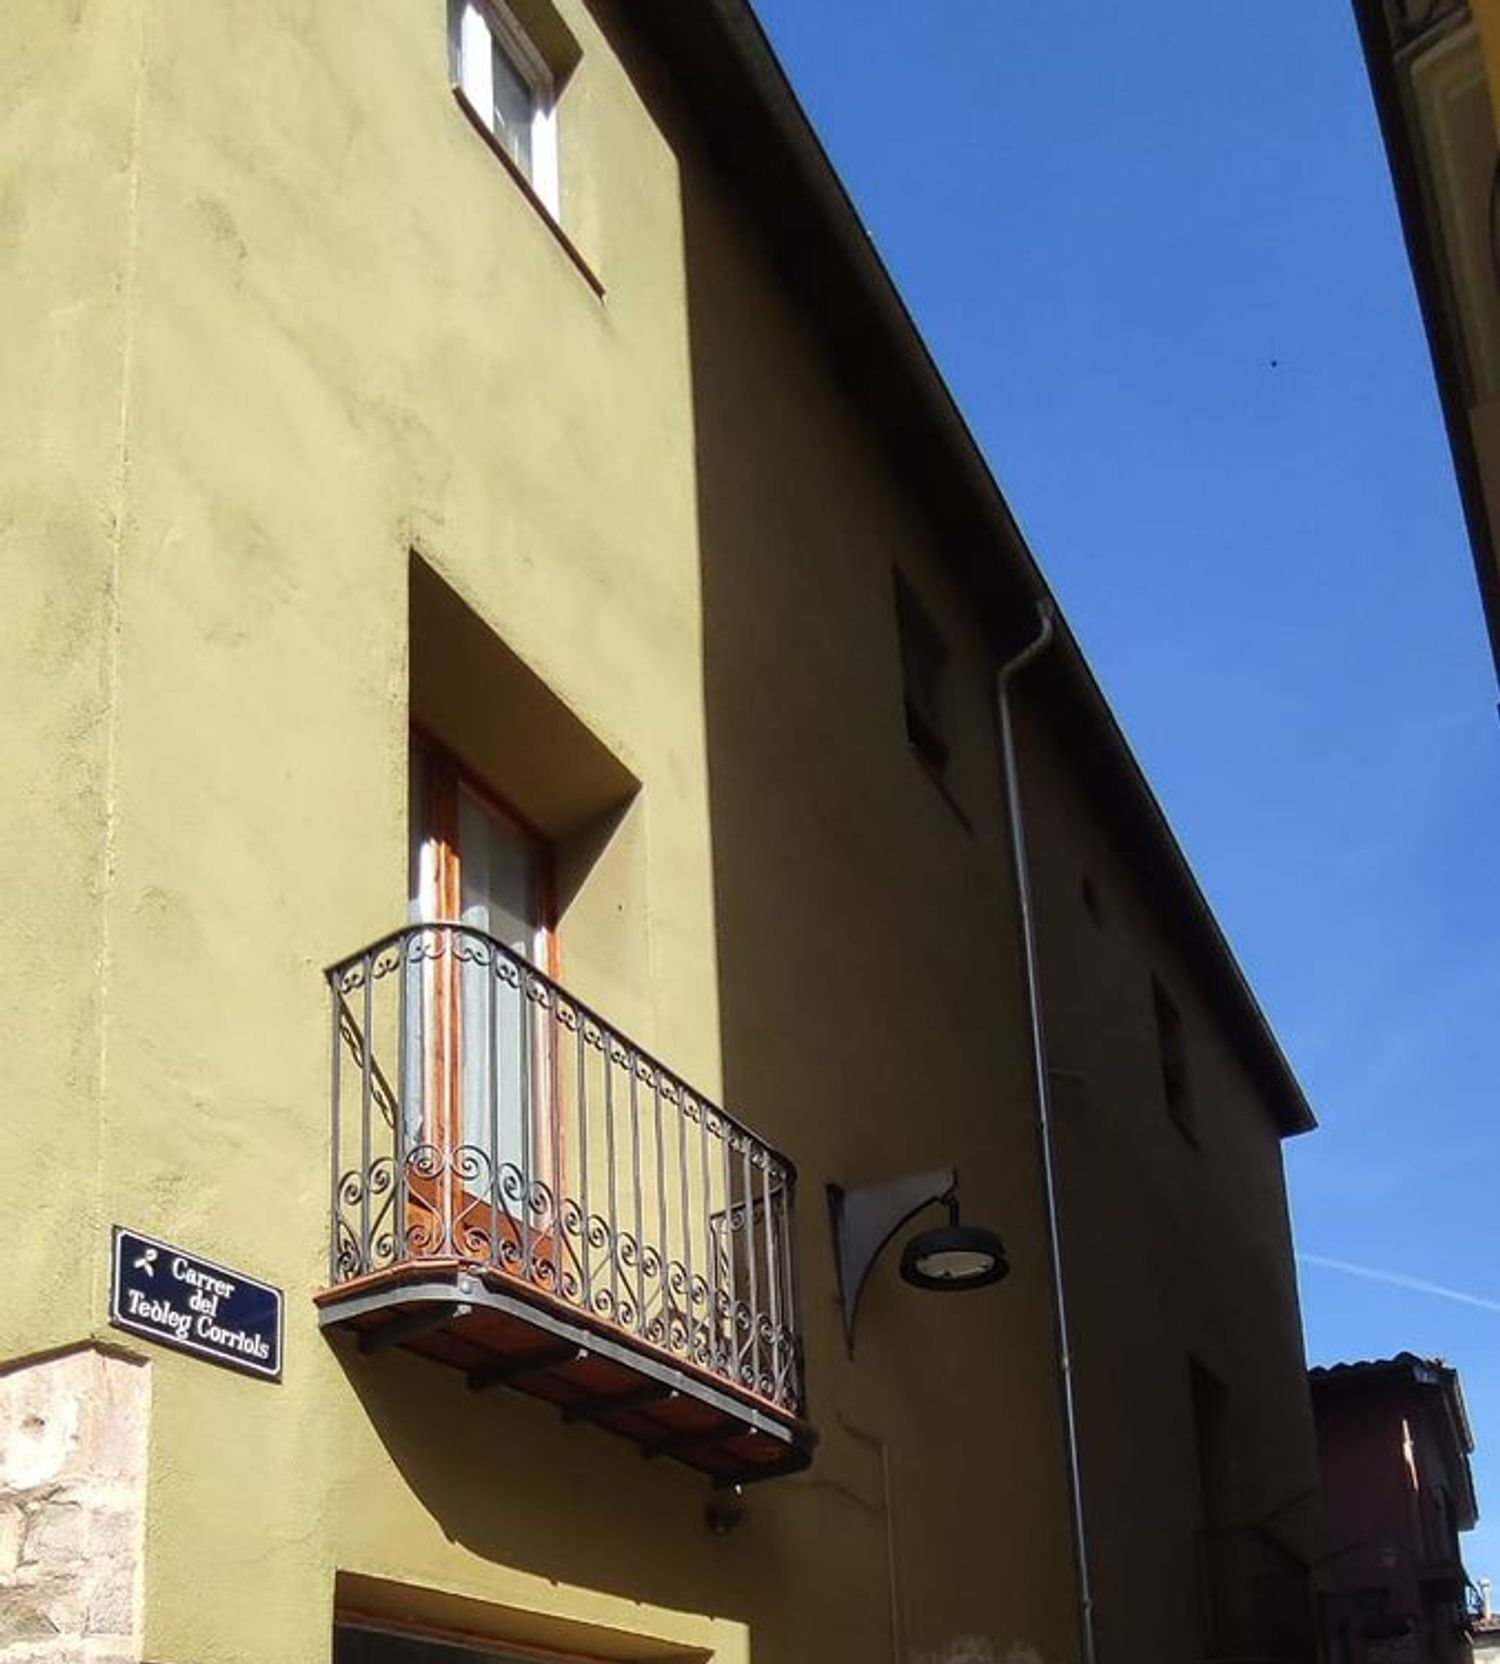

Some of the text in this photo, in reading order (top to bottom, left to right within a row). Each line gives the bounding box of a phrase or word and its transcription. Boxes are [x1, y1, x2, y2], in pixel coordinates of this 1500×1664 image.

[172, 1257, 235, 1299] Carrer
[189, 1290, 218, 1316] del
[128, 1290, 270, 1359] Teòleg Corriols
